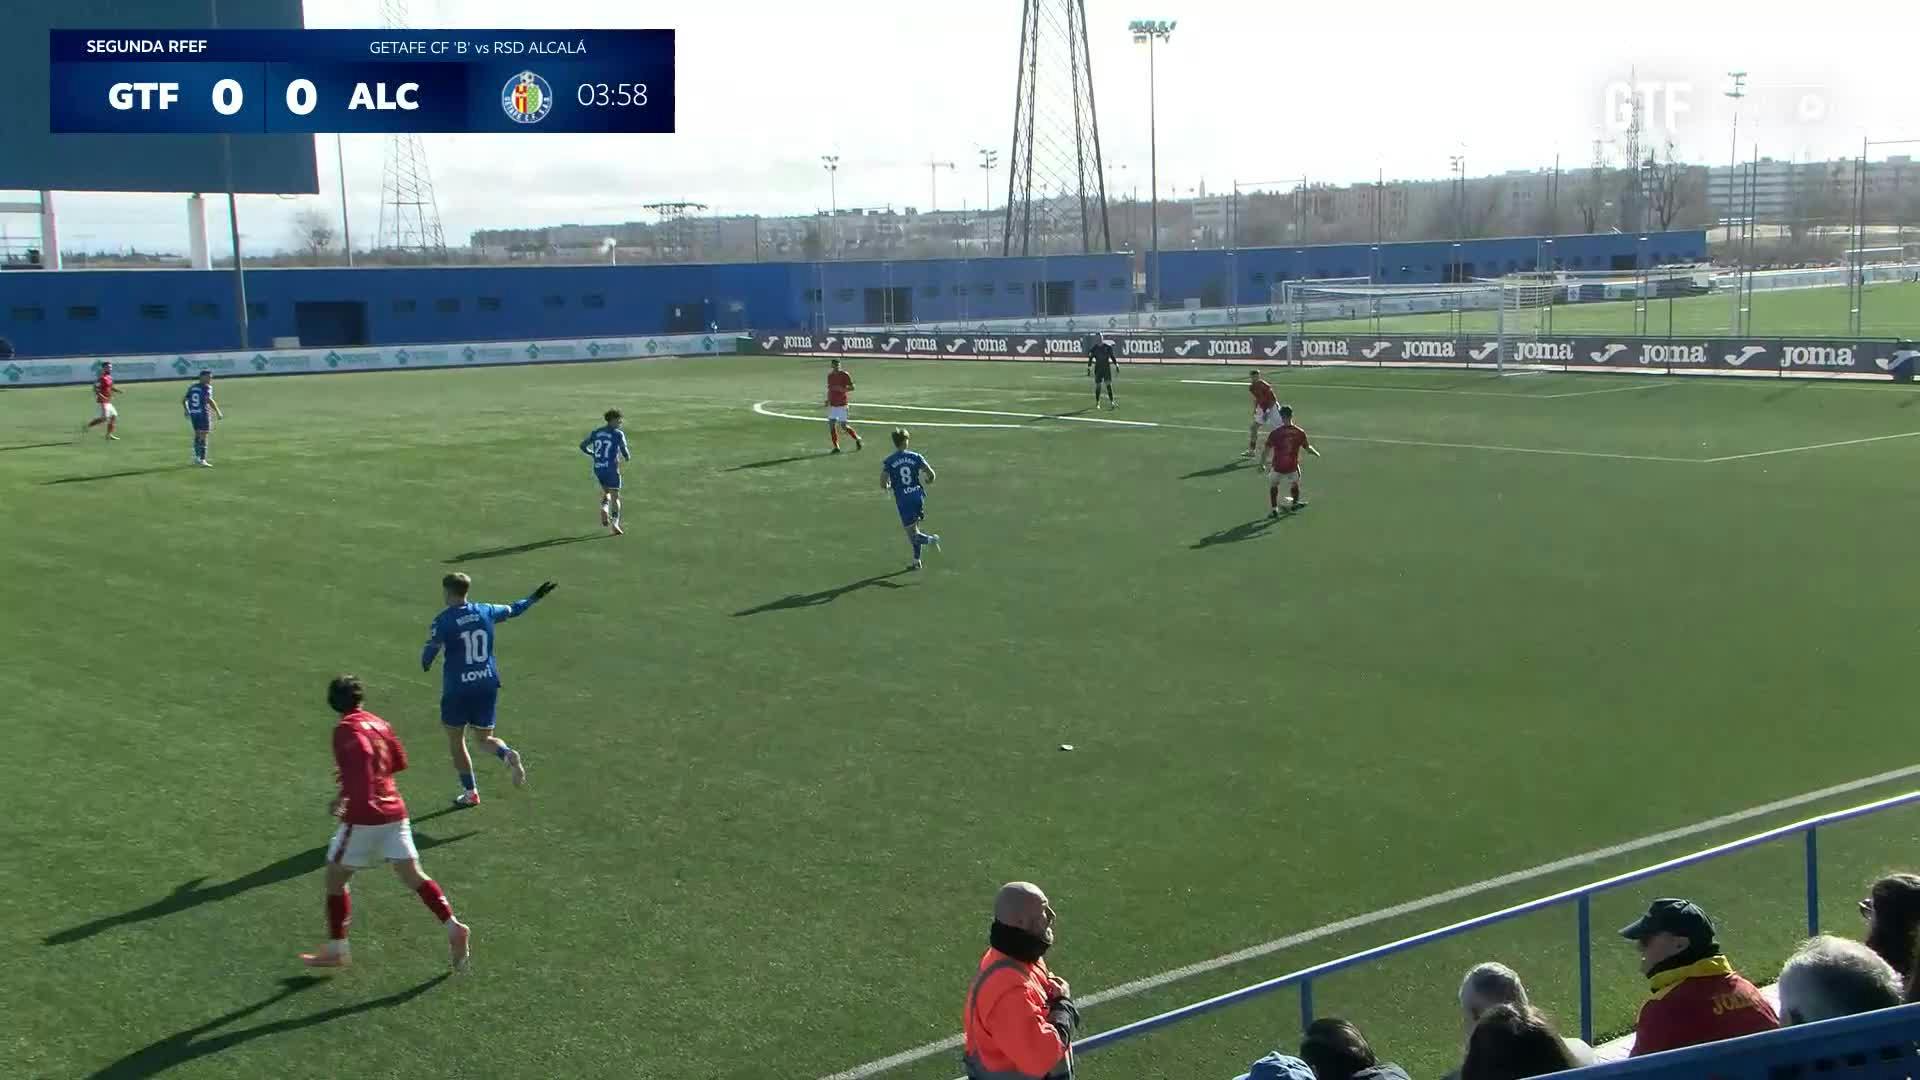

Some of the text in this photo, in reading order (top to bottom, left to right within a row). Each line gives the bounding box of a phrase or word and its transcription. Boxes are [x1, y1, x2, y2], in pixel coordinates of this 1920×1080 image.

[191, 393, 200, 407] 9
[594, 439, 612, 458] 27
[900, 466, 911, 485] 8
[459, 629, 488, 665] 10
